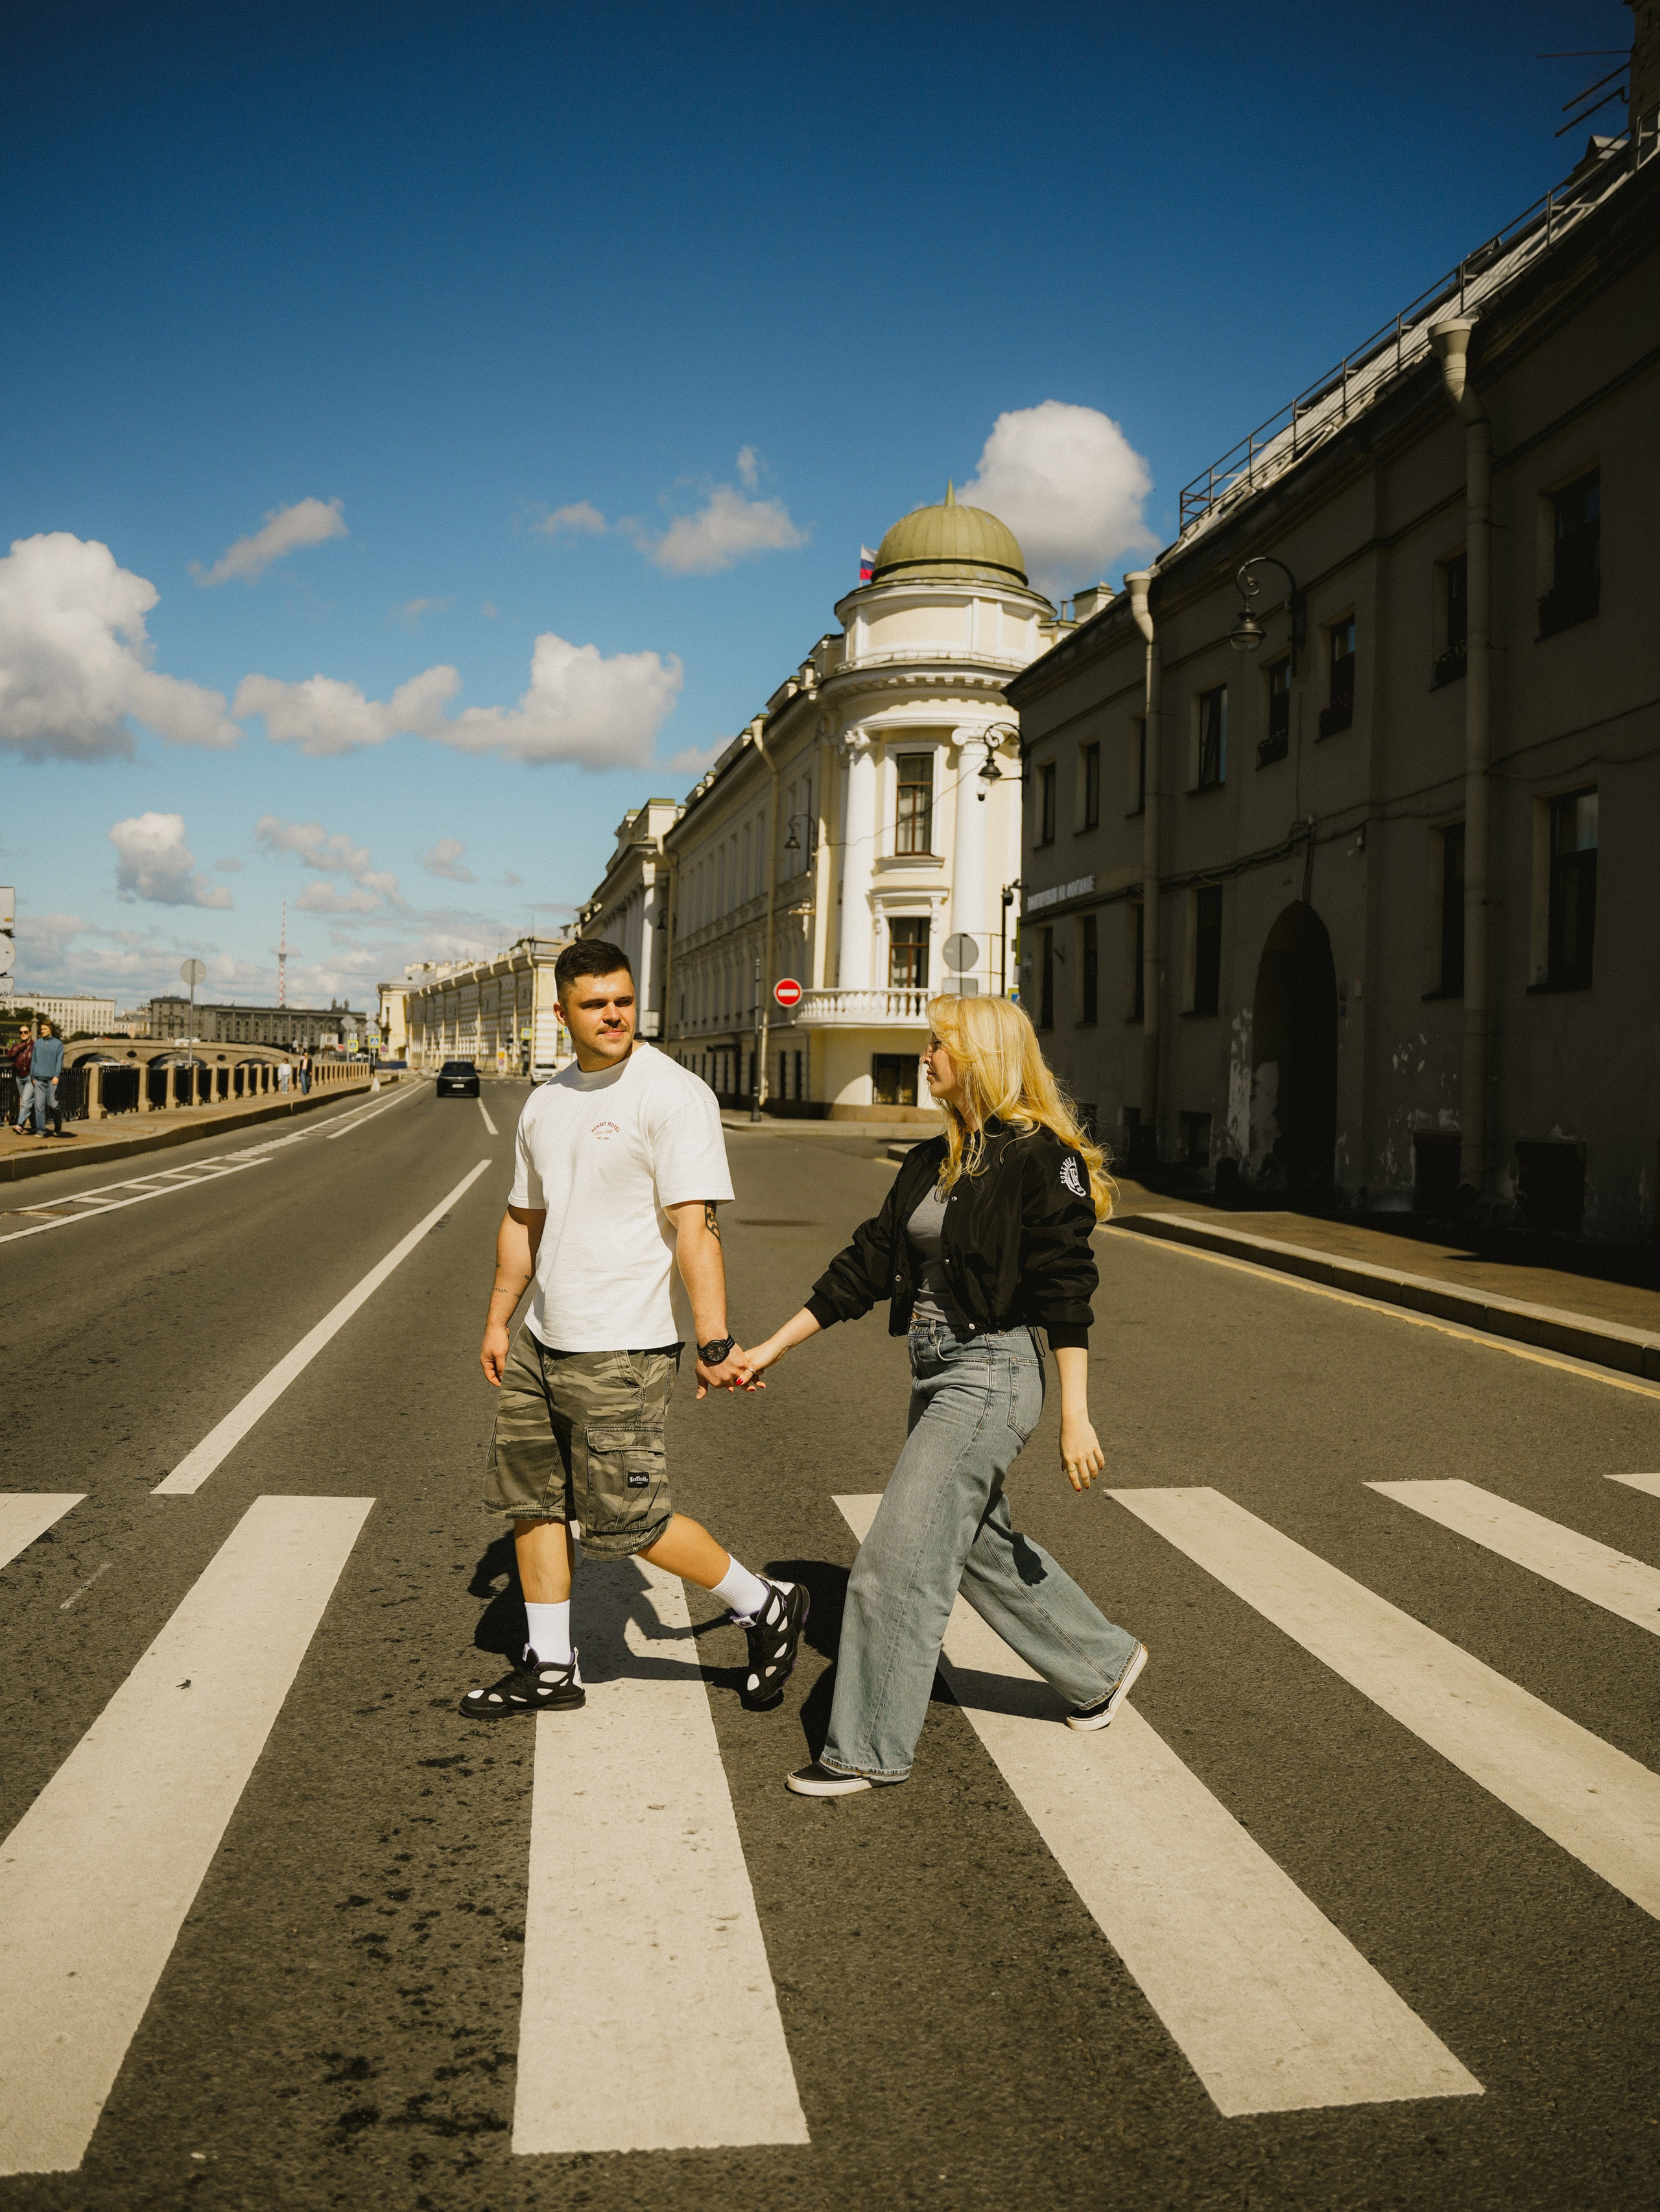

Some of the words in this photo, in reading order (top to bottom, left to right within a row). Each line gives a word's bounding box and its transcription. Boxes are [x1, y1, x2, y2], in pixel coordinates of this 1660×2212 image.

[591, 1121, 607, 1133] SUNSET
[608, 1122, 620, 1133] MOTEL
[1060, 1156, 1073, 1183] COLLEGE
